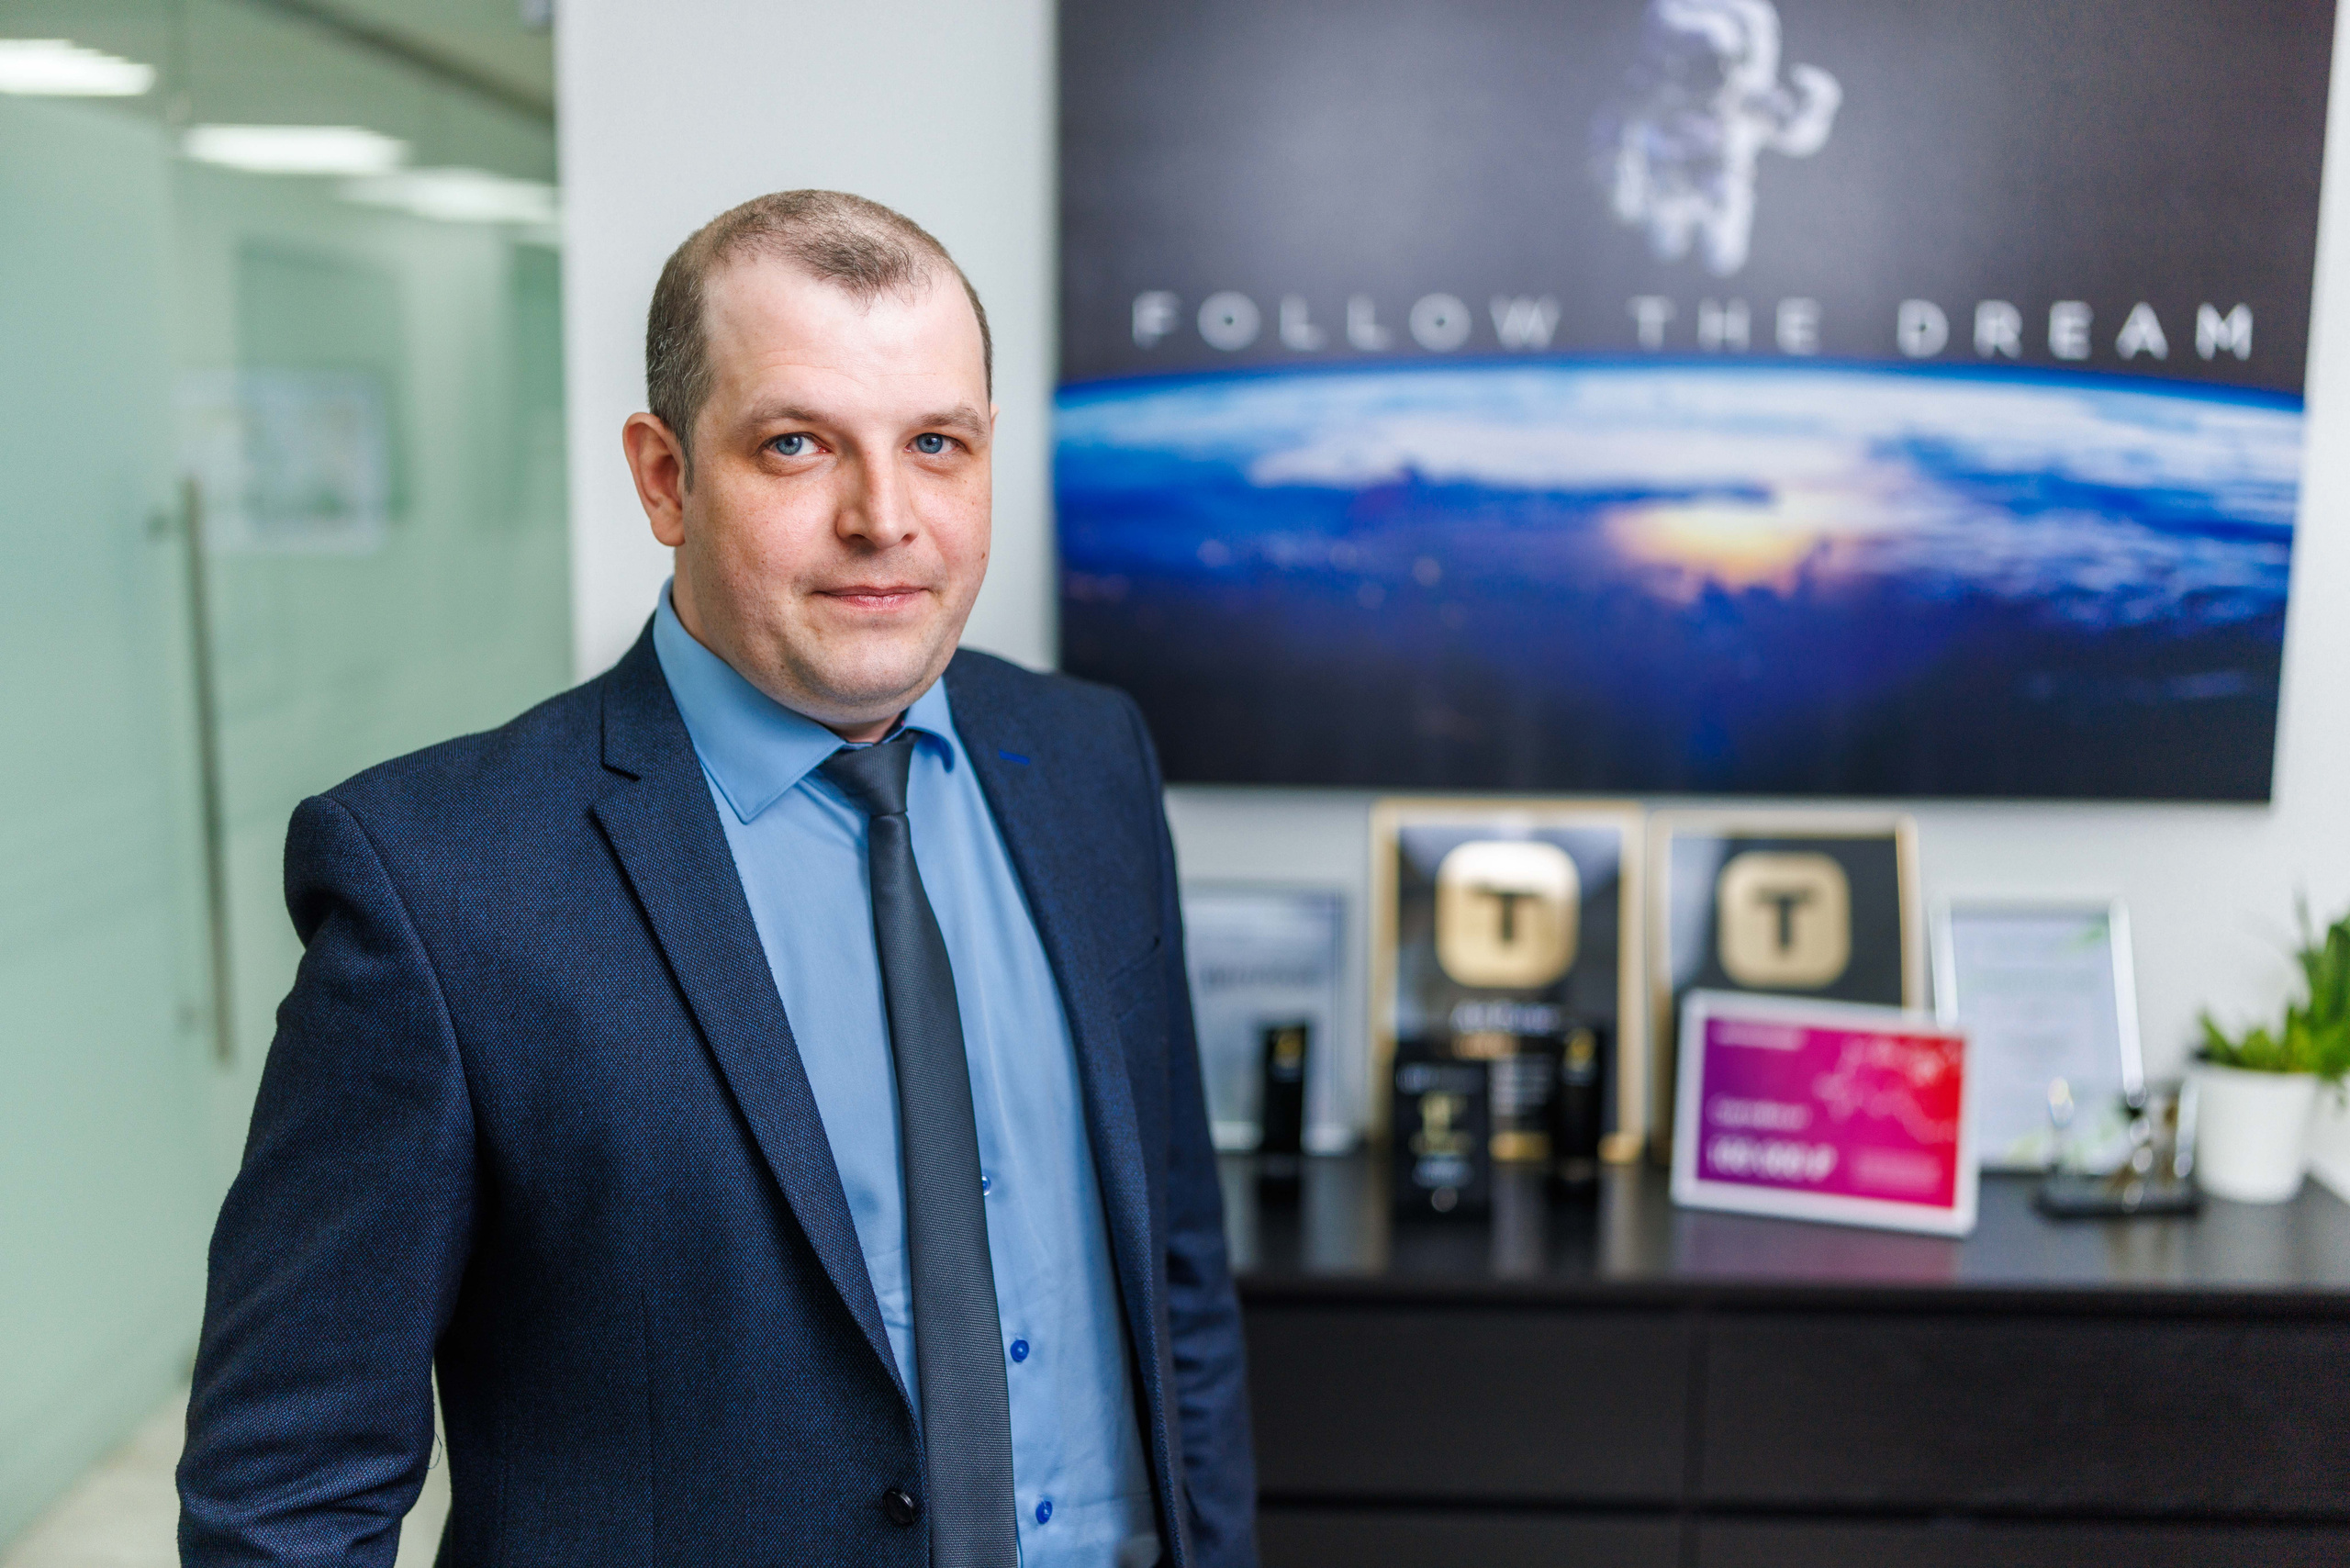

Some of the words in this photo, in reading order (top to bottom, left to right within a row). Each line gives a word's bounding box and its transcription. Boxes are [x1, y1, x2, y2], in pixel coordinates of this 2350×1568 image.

[1133, 291, 1560, 351] FOLLOW
[1630, 296, 1821, 353] THE
[1898, 298, 2255, 362] DREAM
[1473, 881, 1546, 949] T
[1752, 887, 1817, 955] T
